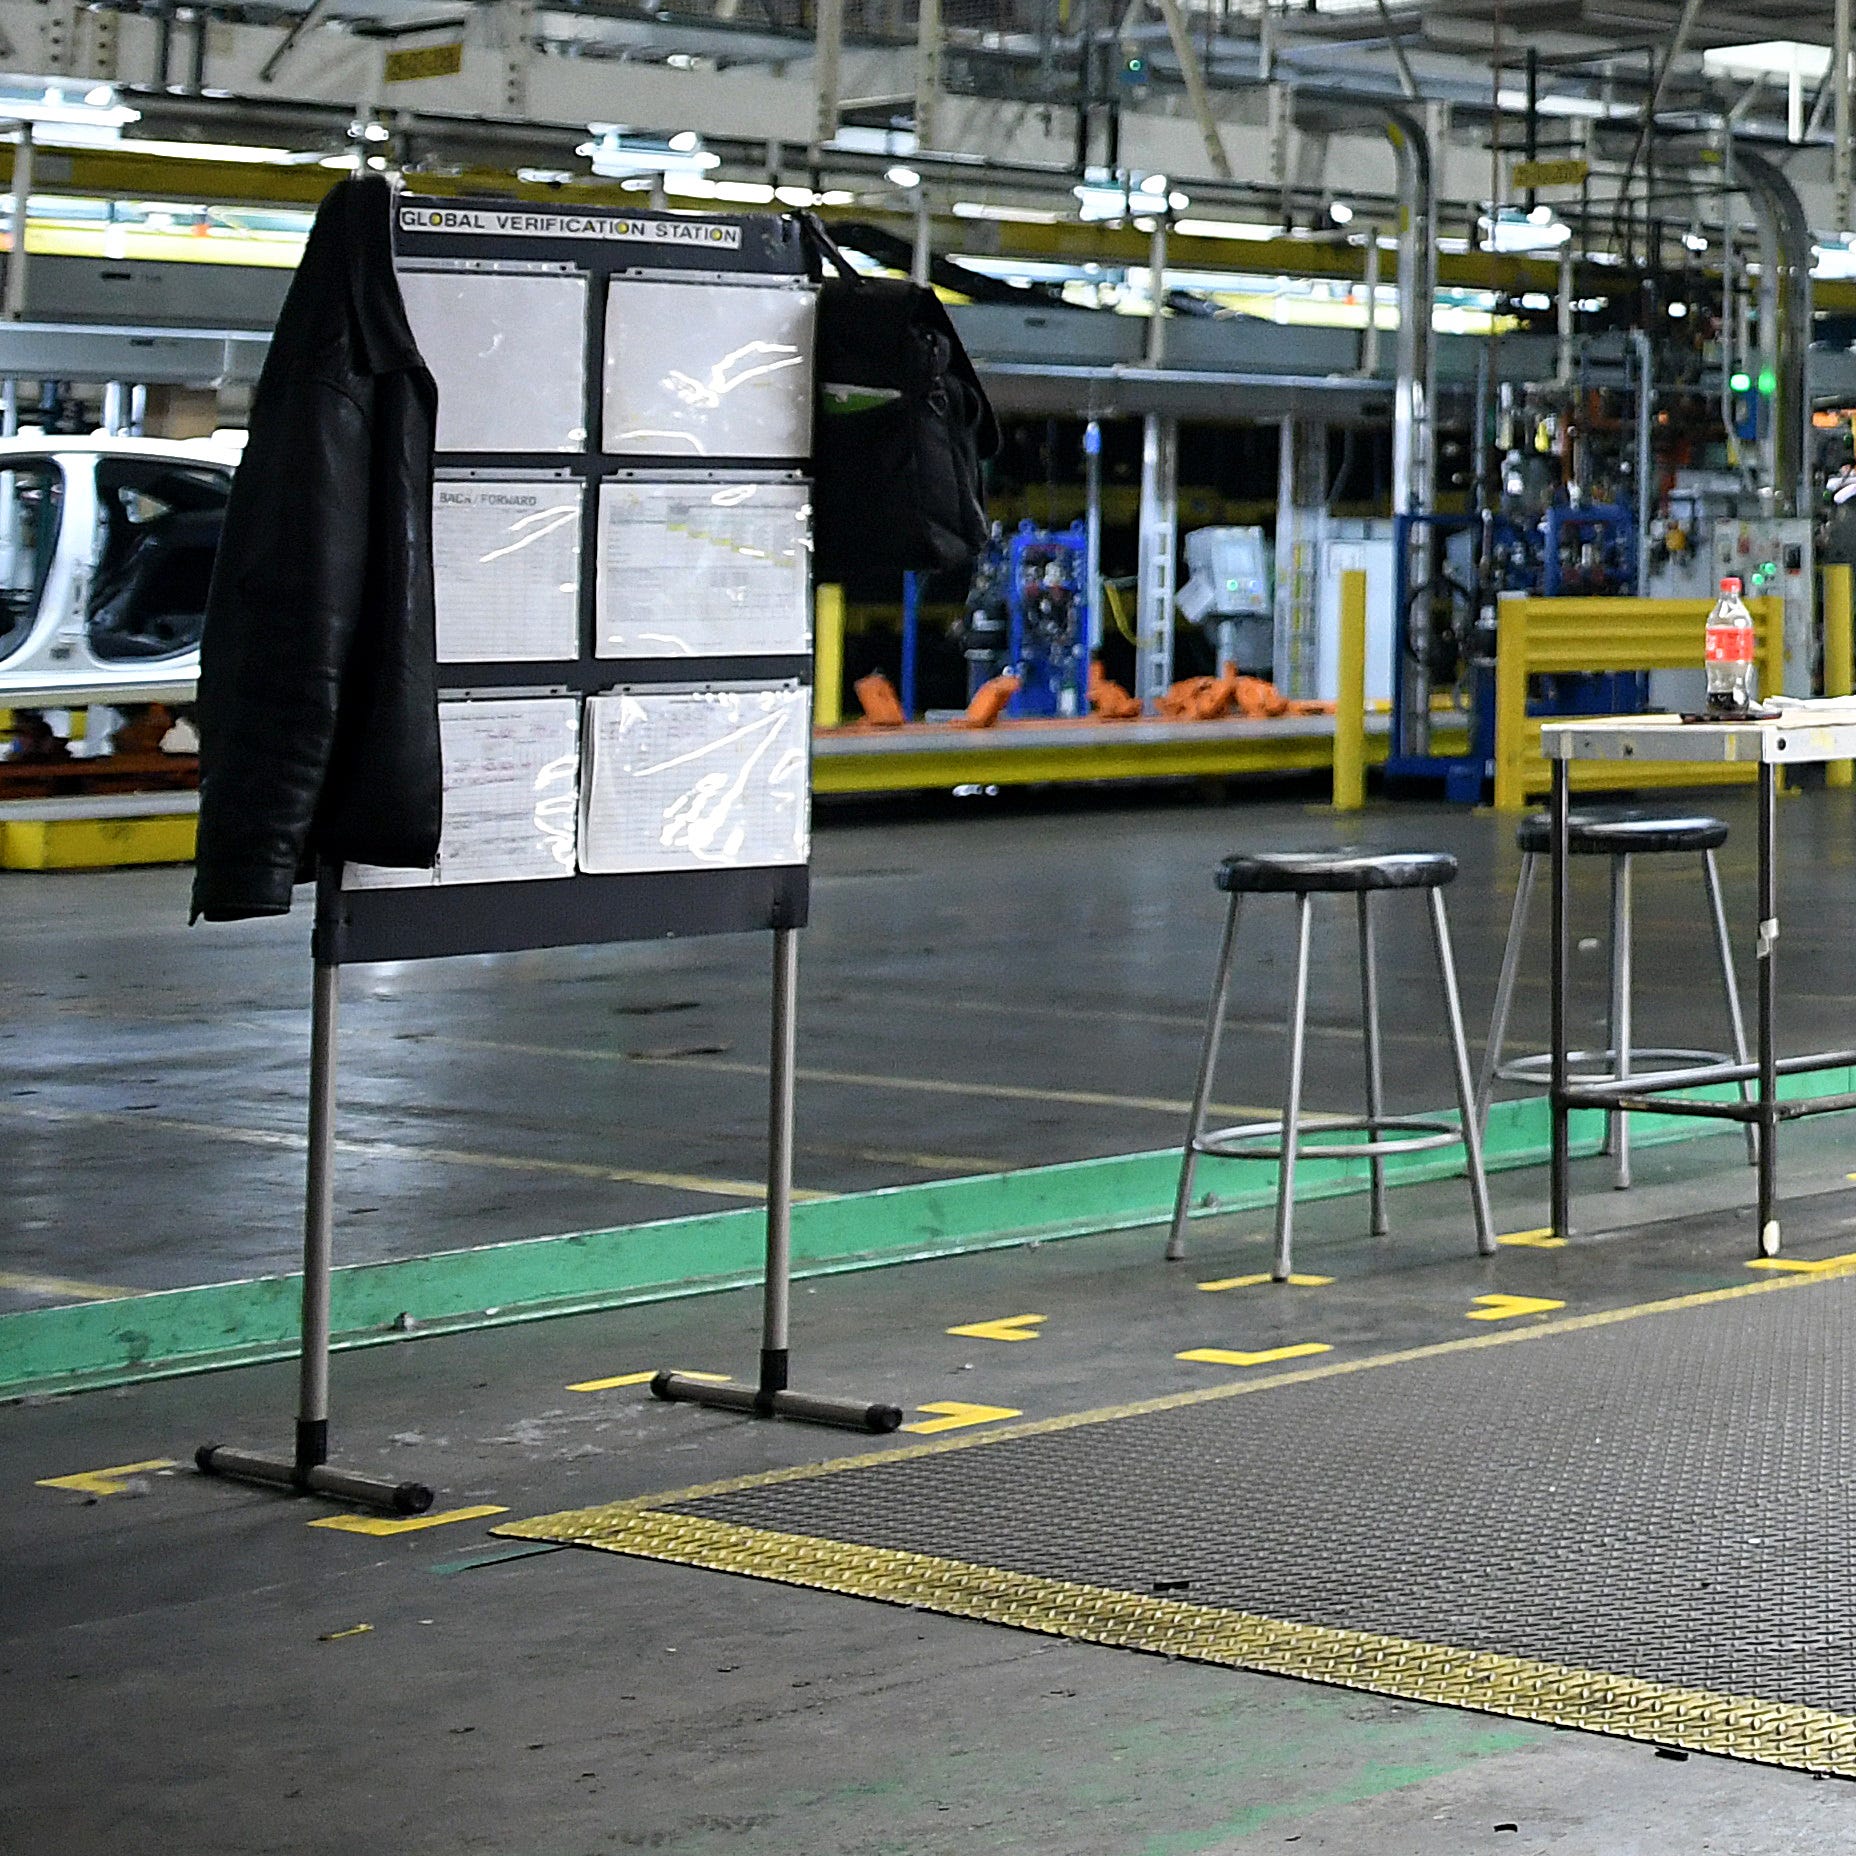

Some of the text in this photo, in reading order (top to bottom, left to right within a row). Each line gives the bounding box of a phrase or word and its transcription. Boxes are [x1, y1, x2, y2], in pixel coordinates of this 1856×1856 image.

[401, 210, 737, 243] GLOBAL VERIFICATION STATION
